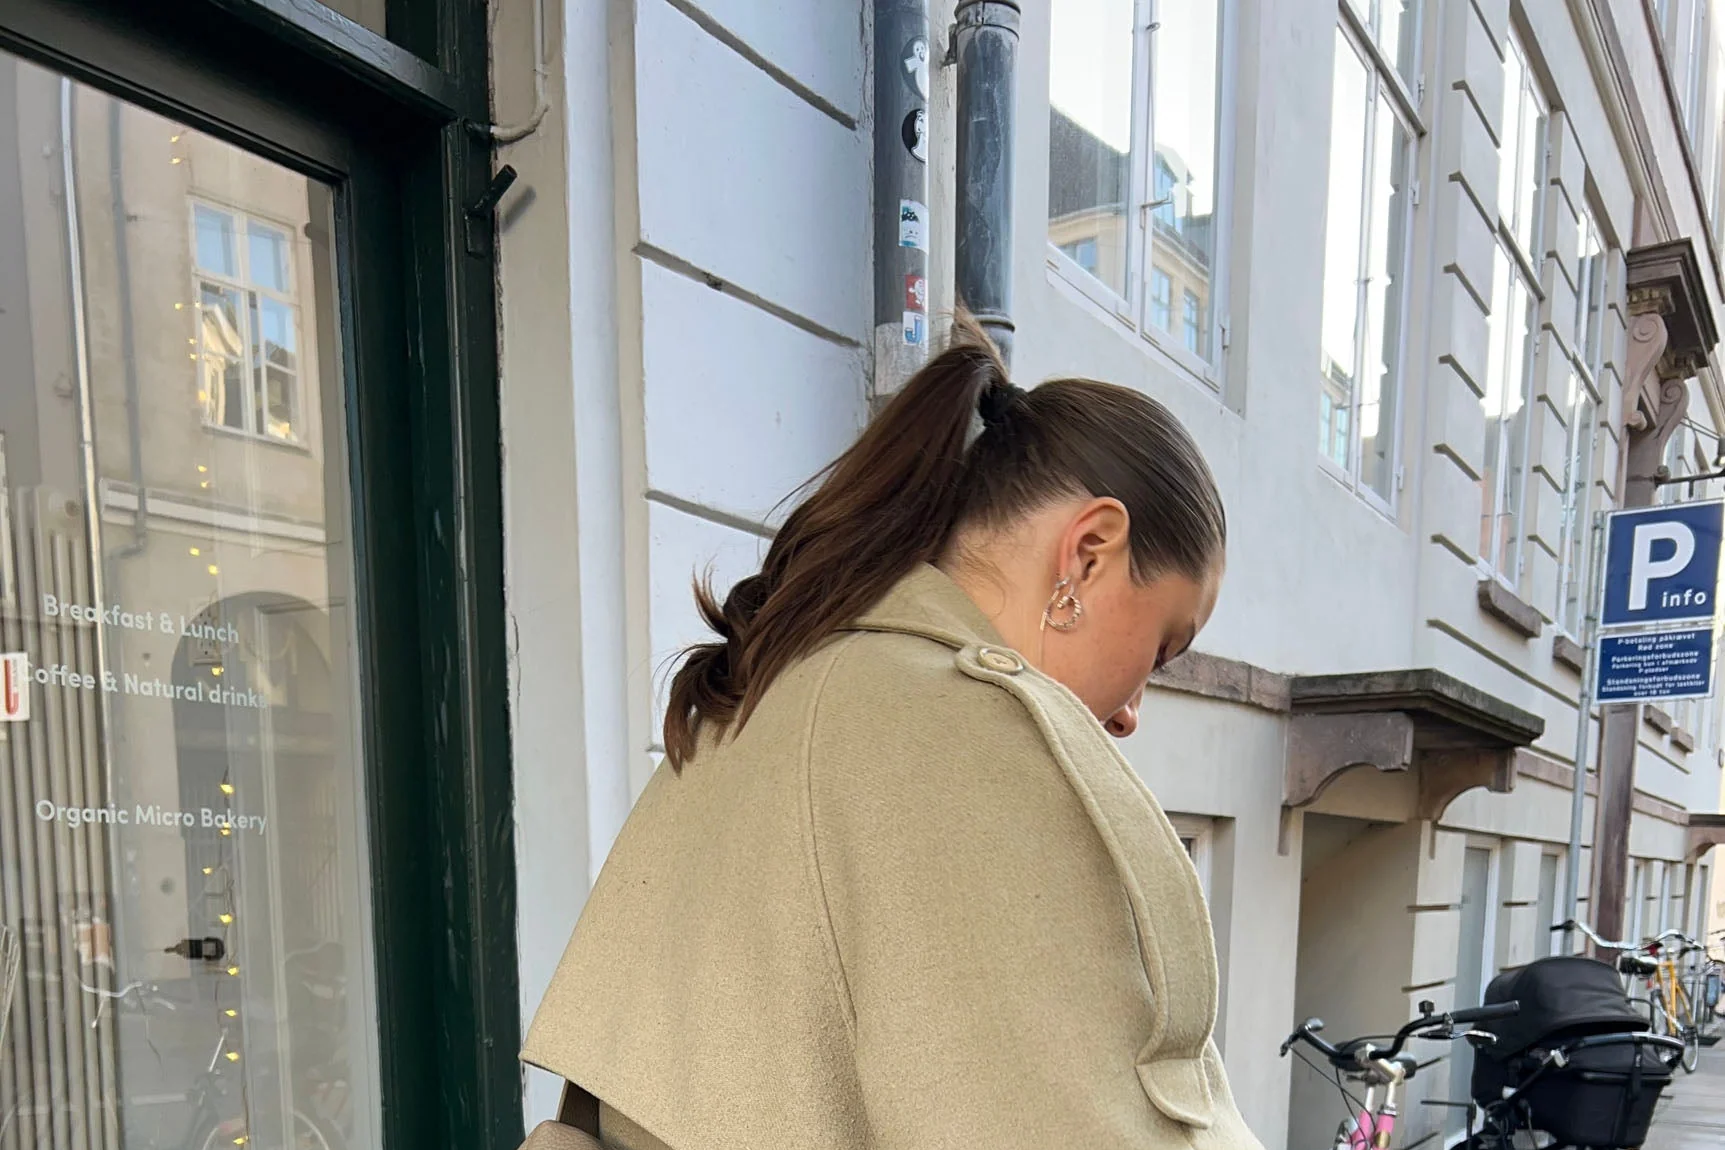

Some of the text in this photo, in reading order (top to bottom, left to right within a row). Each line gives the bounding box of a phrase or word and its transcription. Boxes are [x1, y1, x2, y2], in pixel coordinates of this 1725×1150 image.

[1628, 521, 1695, 610] P
[1661, 589, 1706, 607] info
[43, 593, 239, 643] Breakfast & Lunch
[103, 671, 118, 692] &
[125, 673, 202, 702] Natural
[208, 683, 268, 709] drinks
[36, 799, 267, 835] Organic Micro Bakery
